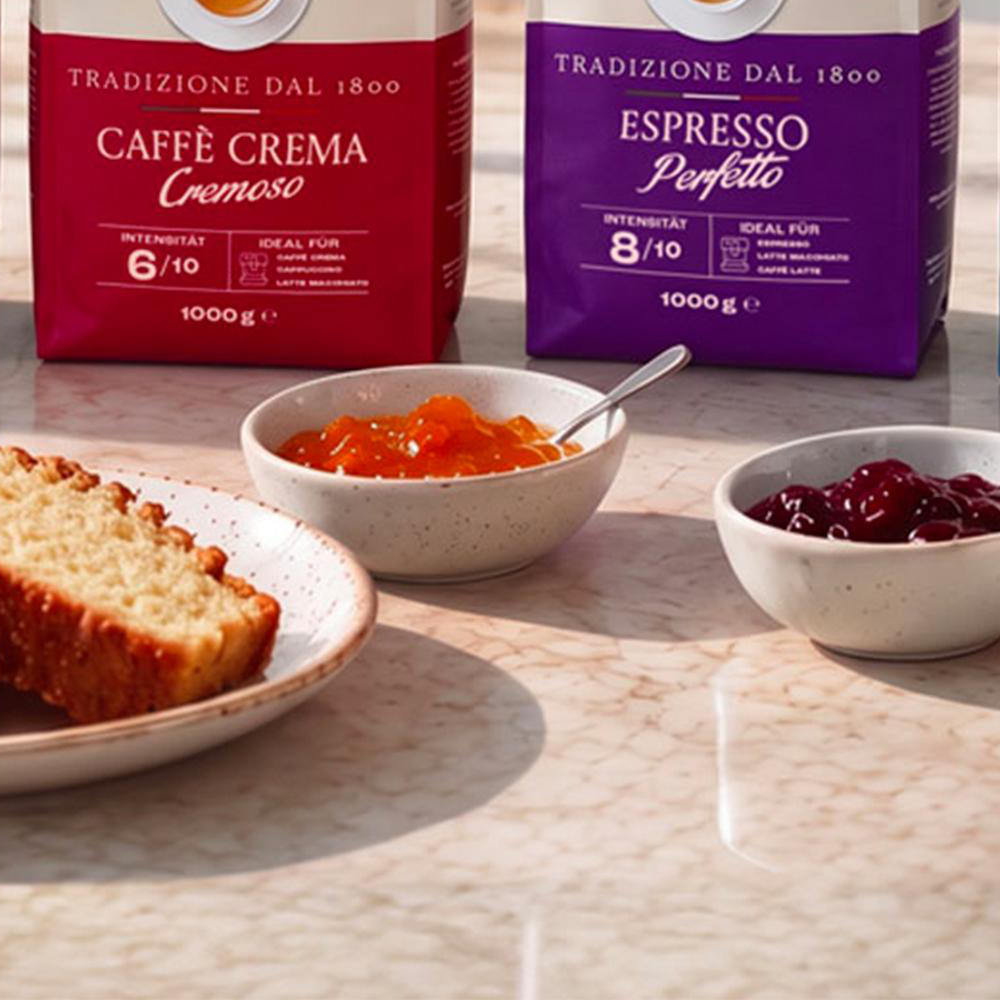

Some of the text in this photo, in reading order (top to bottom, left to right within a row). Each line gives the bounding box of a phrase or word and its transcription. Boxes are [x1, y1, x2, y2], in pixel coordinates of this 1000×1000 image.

[67, 68, 400, 96] TRADIZIONE DAL 1800
[554, 53, 881, 84] TRADIZIONE DAL 1800
[619, 109, 809, 151] ESPRESSO
[97, 124, 368, 166] CAFFÈ CREMA
[159, 166, 305, 208] Cremoso
[636, 151, 789, 201] Perfetto
[604, 213, 688, 230] INTENSITÄT
[739, 220, 820, 235] IDEAL FÜR
[121, 232, 205, 247] INTENSITÄT
[259, 235, 340, 249] IDEAL FÜR
